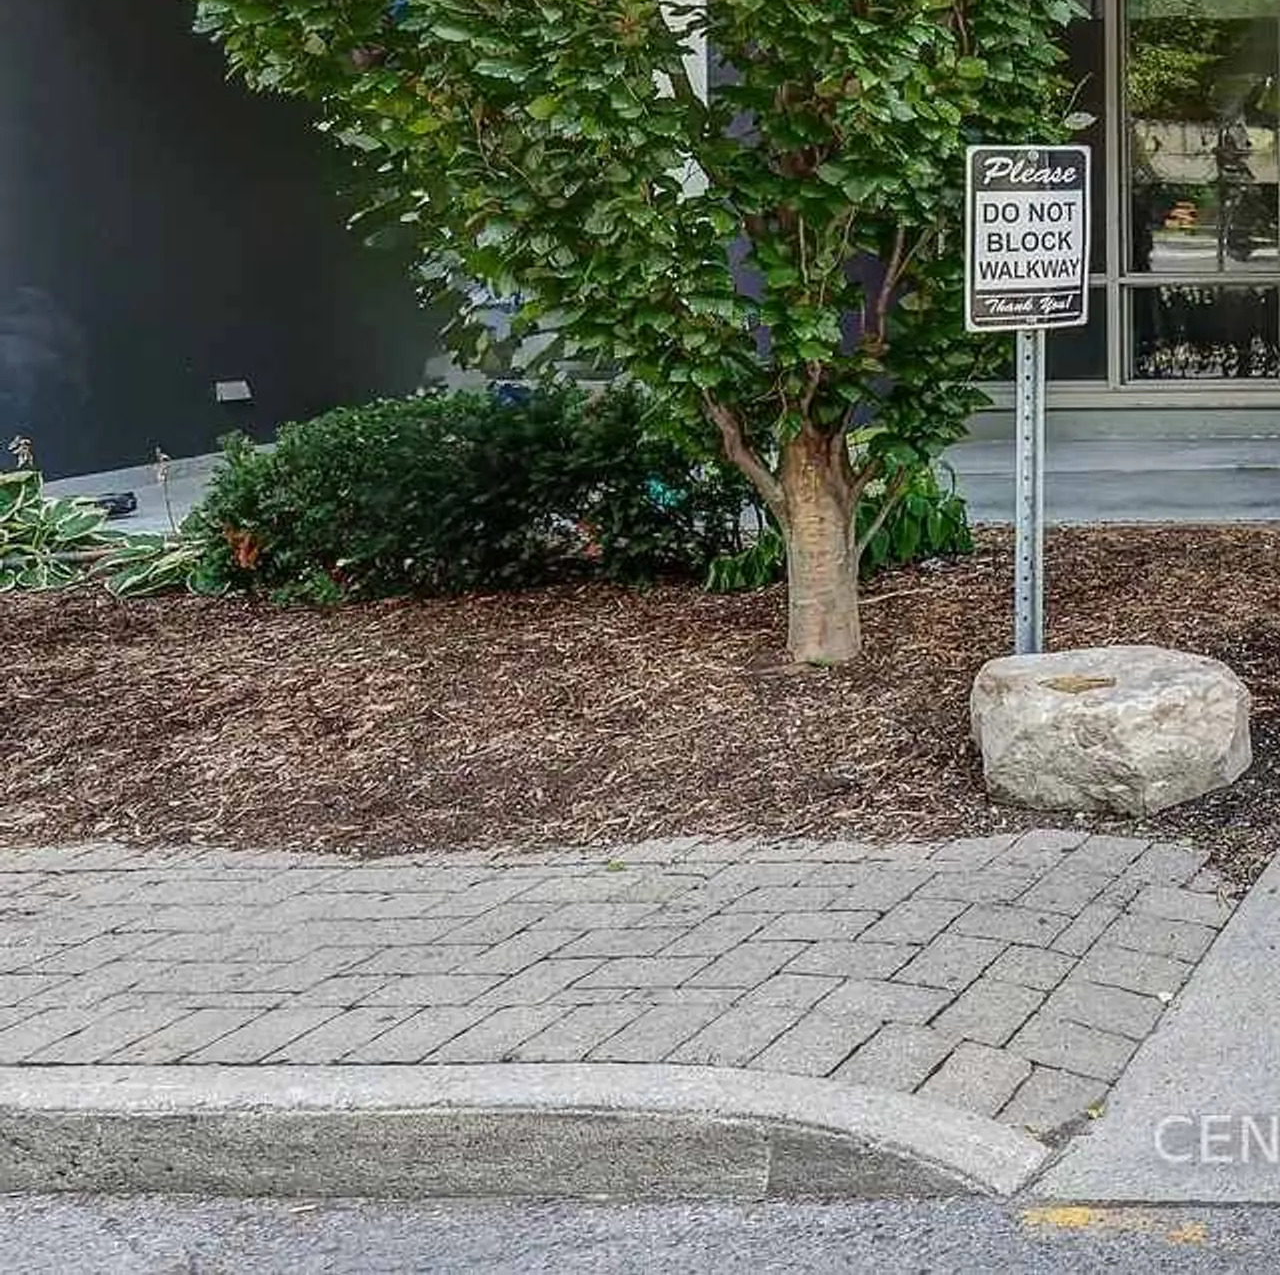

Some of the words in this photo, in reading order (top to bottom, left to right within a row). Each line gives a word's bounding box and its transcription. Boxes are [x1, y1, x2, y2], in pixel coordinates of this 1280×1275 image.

[983, 156, 1077, 185] Please
[983, 203, 1020, 224] DO
[1028, 201, 1077, 223] NOT
[987, 231, 1073, 253] BLOCK
[979, 257, 1080, 281] WALKWAY
[985, 298, 1034, 314] Thank
